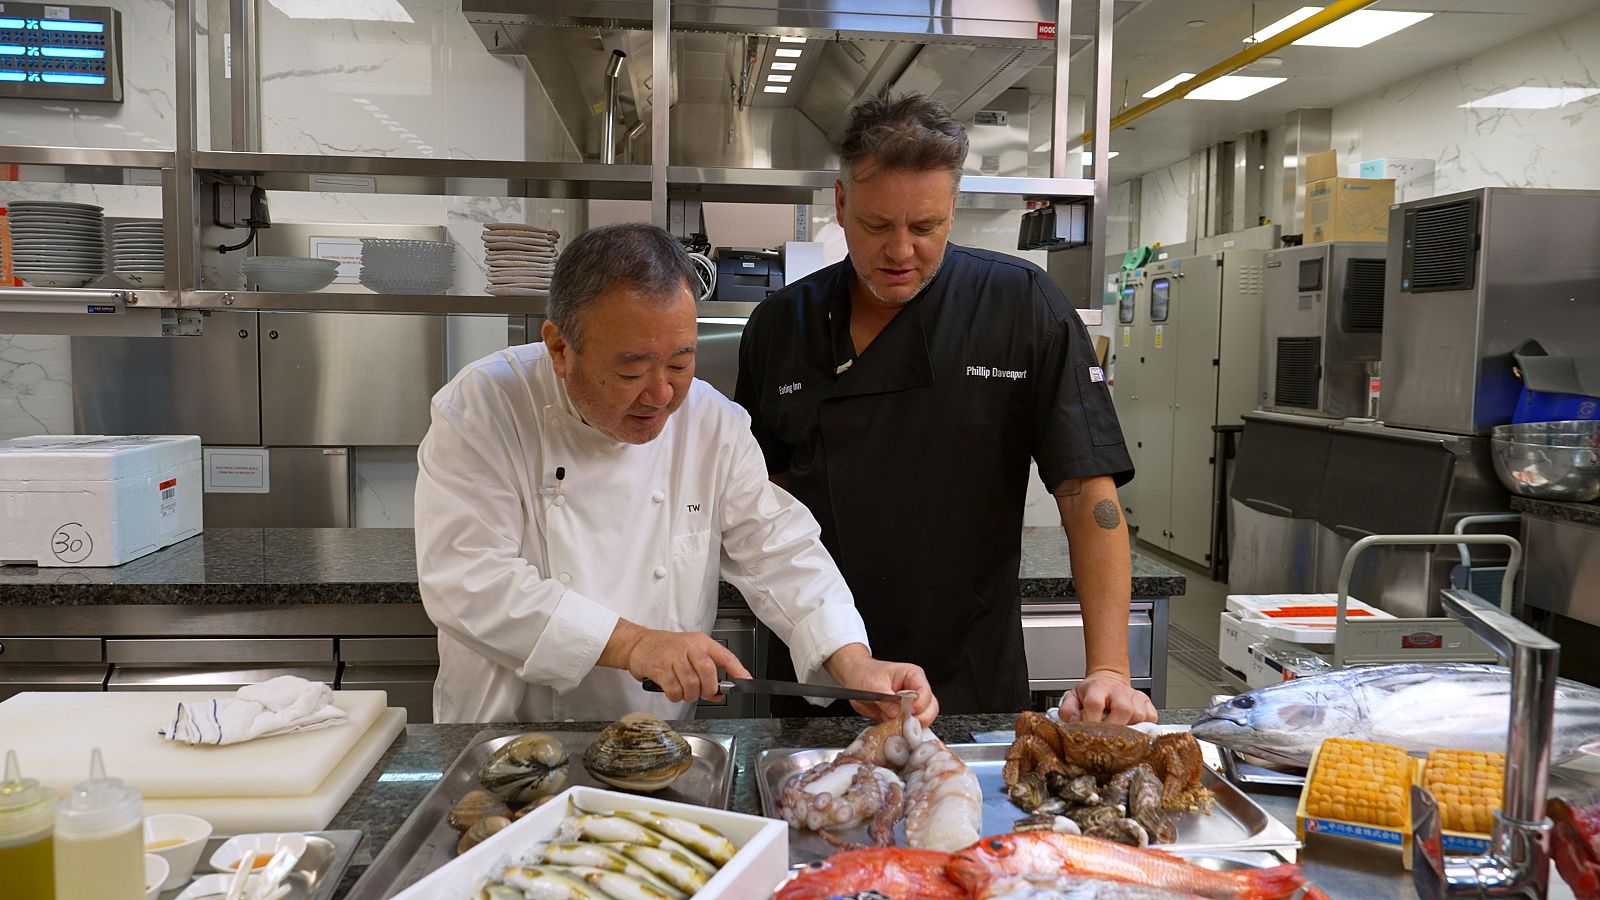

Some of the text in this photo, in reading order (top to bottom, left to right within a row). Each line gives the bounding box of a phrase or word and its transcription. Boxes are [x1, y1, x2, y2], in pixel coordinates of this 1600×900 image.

[966, 366, 1027, 380] Phillip Davenport
[687, 503, 701, 513] TW
[55, 532, 83, 554] 30
